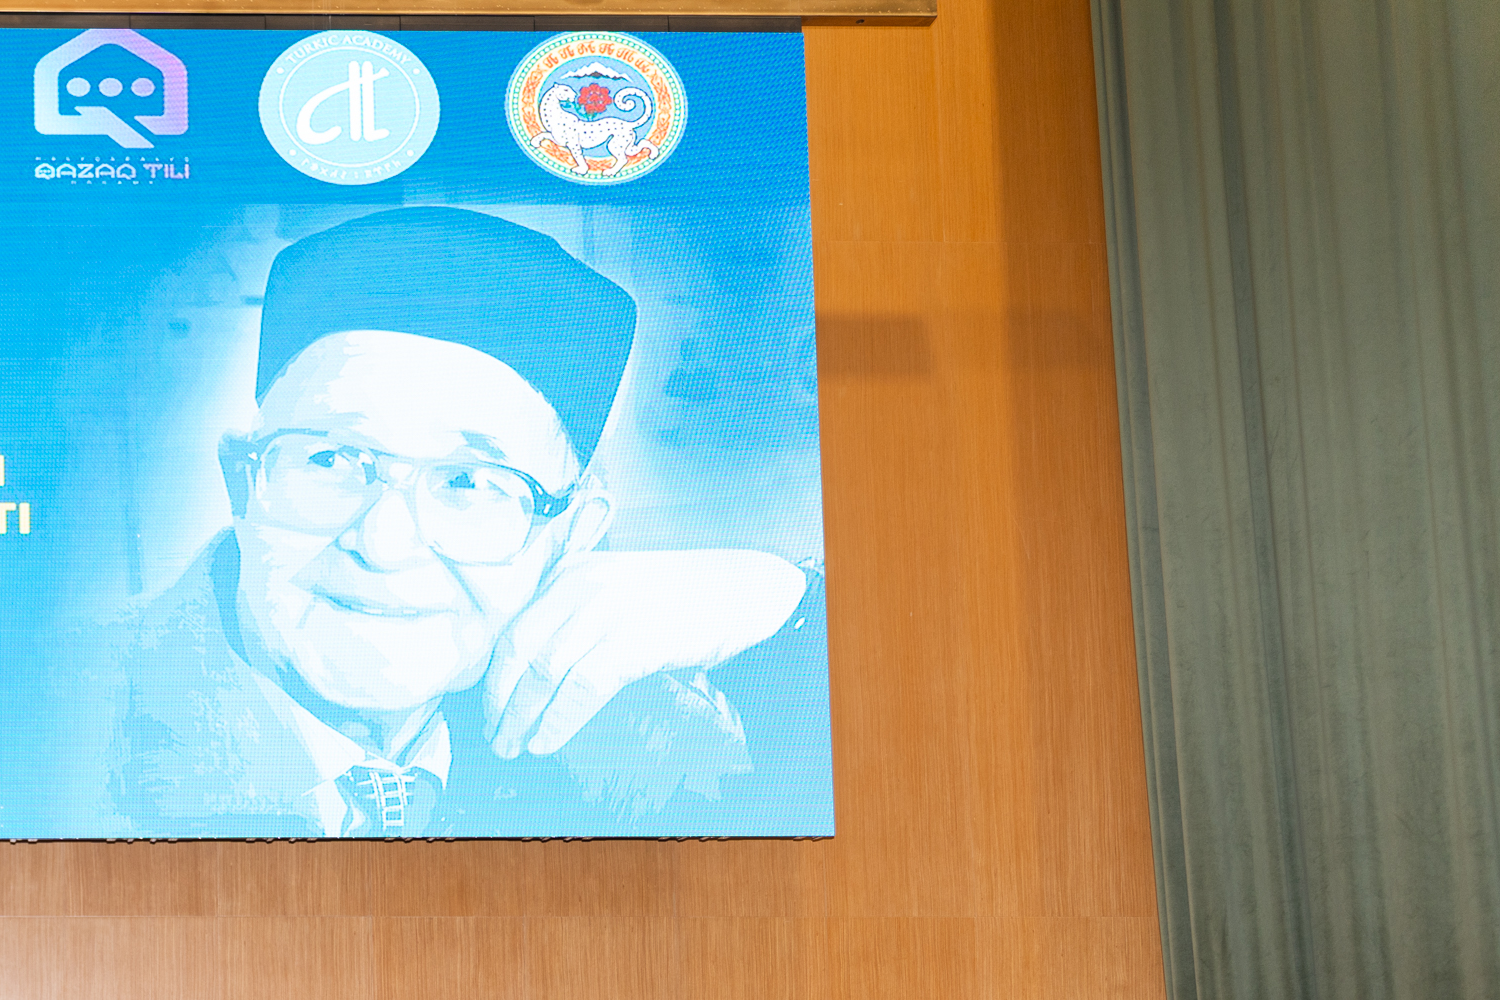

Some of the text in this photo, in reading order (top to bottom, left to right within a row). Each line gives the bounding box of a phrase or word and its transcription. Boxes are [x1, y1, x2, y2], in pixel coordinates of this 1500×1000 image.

[285, 34, 412, 65] TURKIC ACADEMY
[34, 163, 137, 181] QAZAQ
